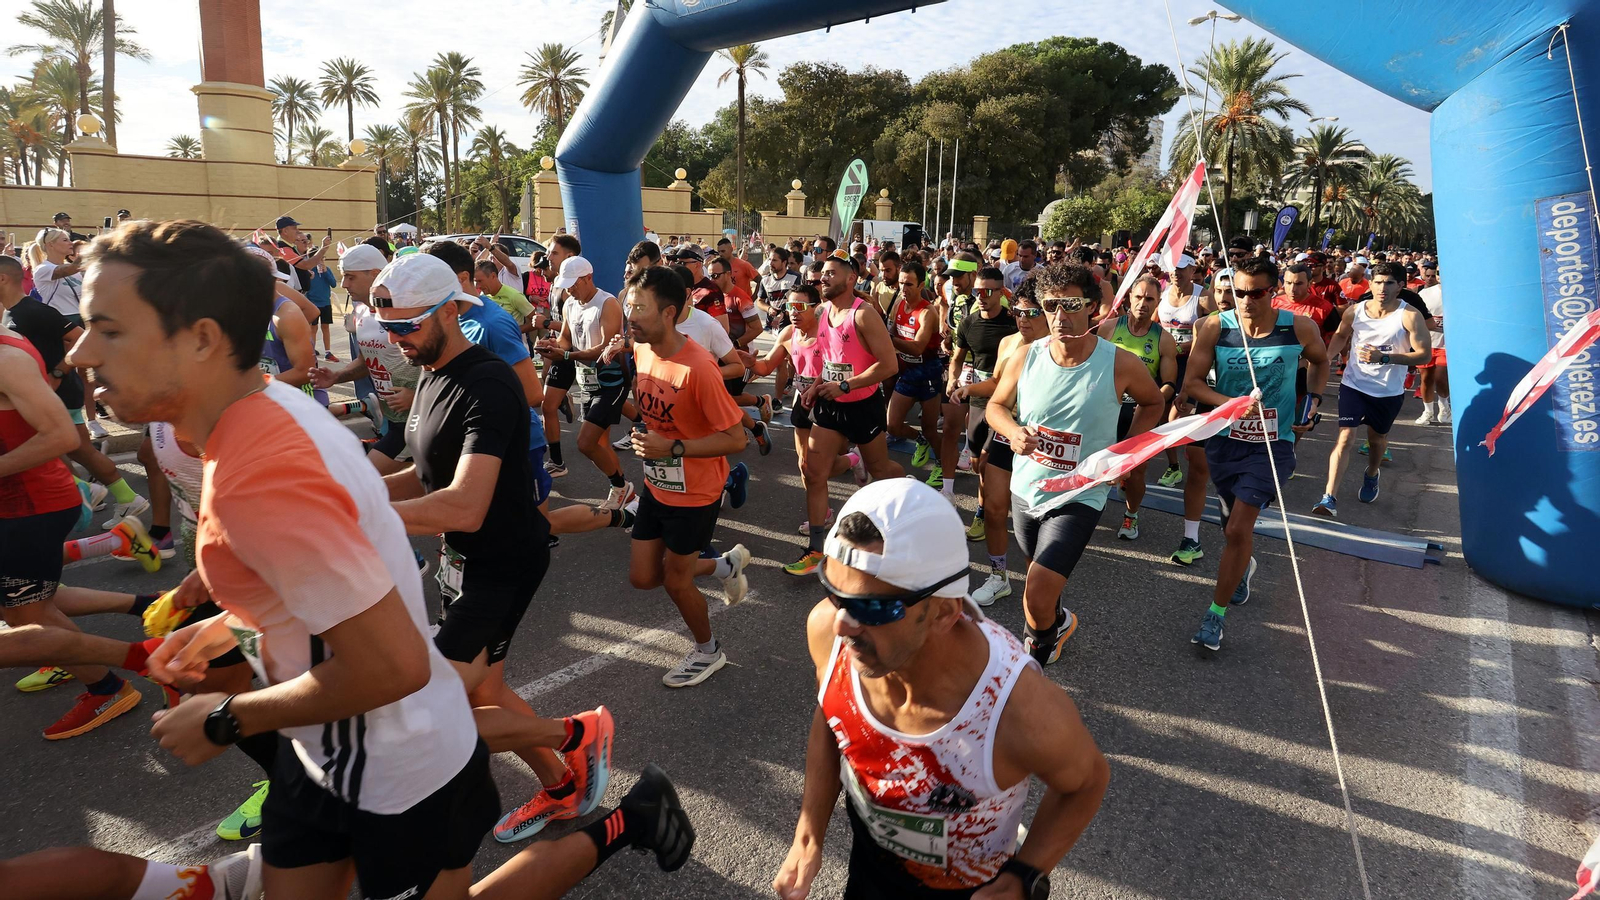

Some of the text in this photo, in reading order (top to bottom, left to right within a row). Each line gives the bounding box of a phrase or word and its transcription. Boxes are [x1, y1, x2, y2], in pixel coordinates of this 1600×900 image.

[1227, 356, 1285, 365] COSTA
[827, 371, 844, 382] 120
[1037, 439, 1065, 458] 390
[652, 467, 667, 479] 13
